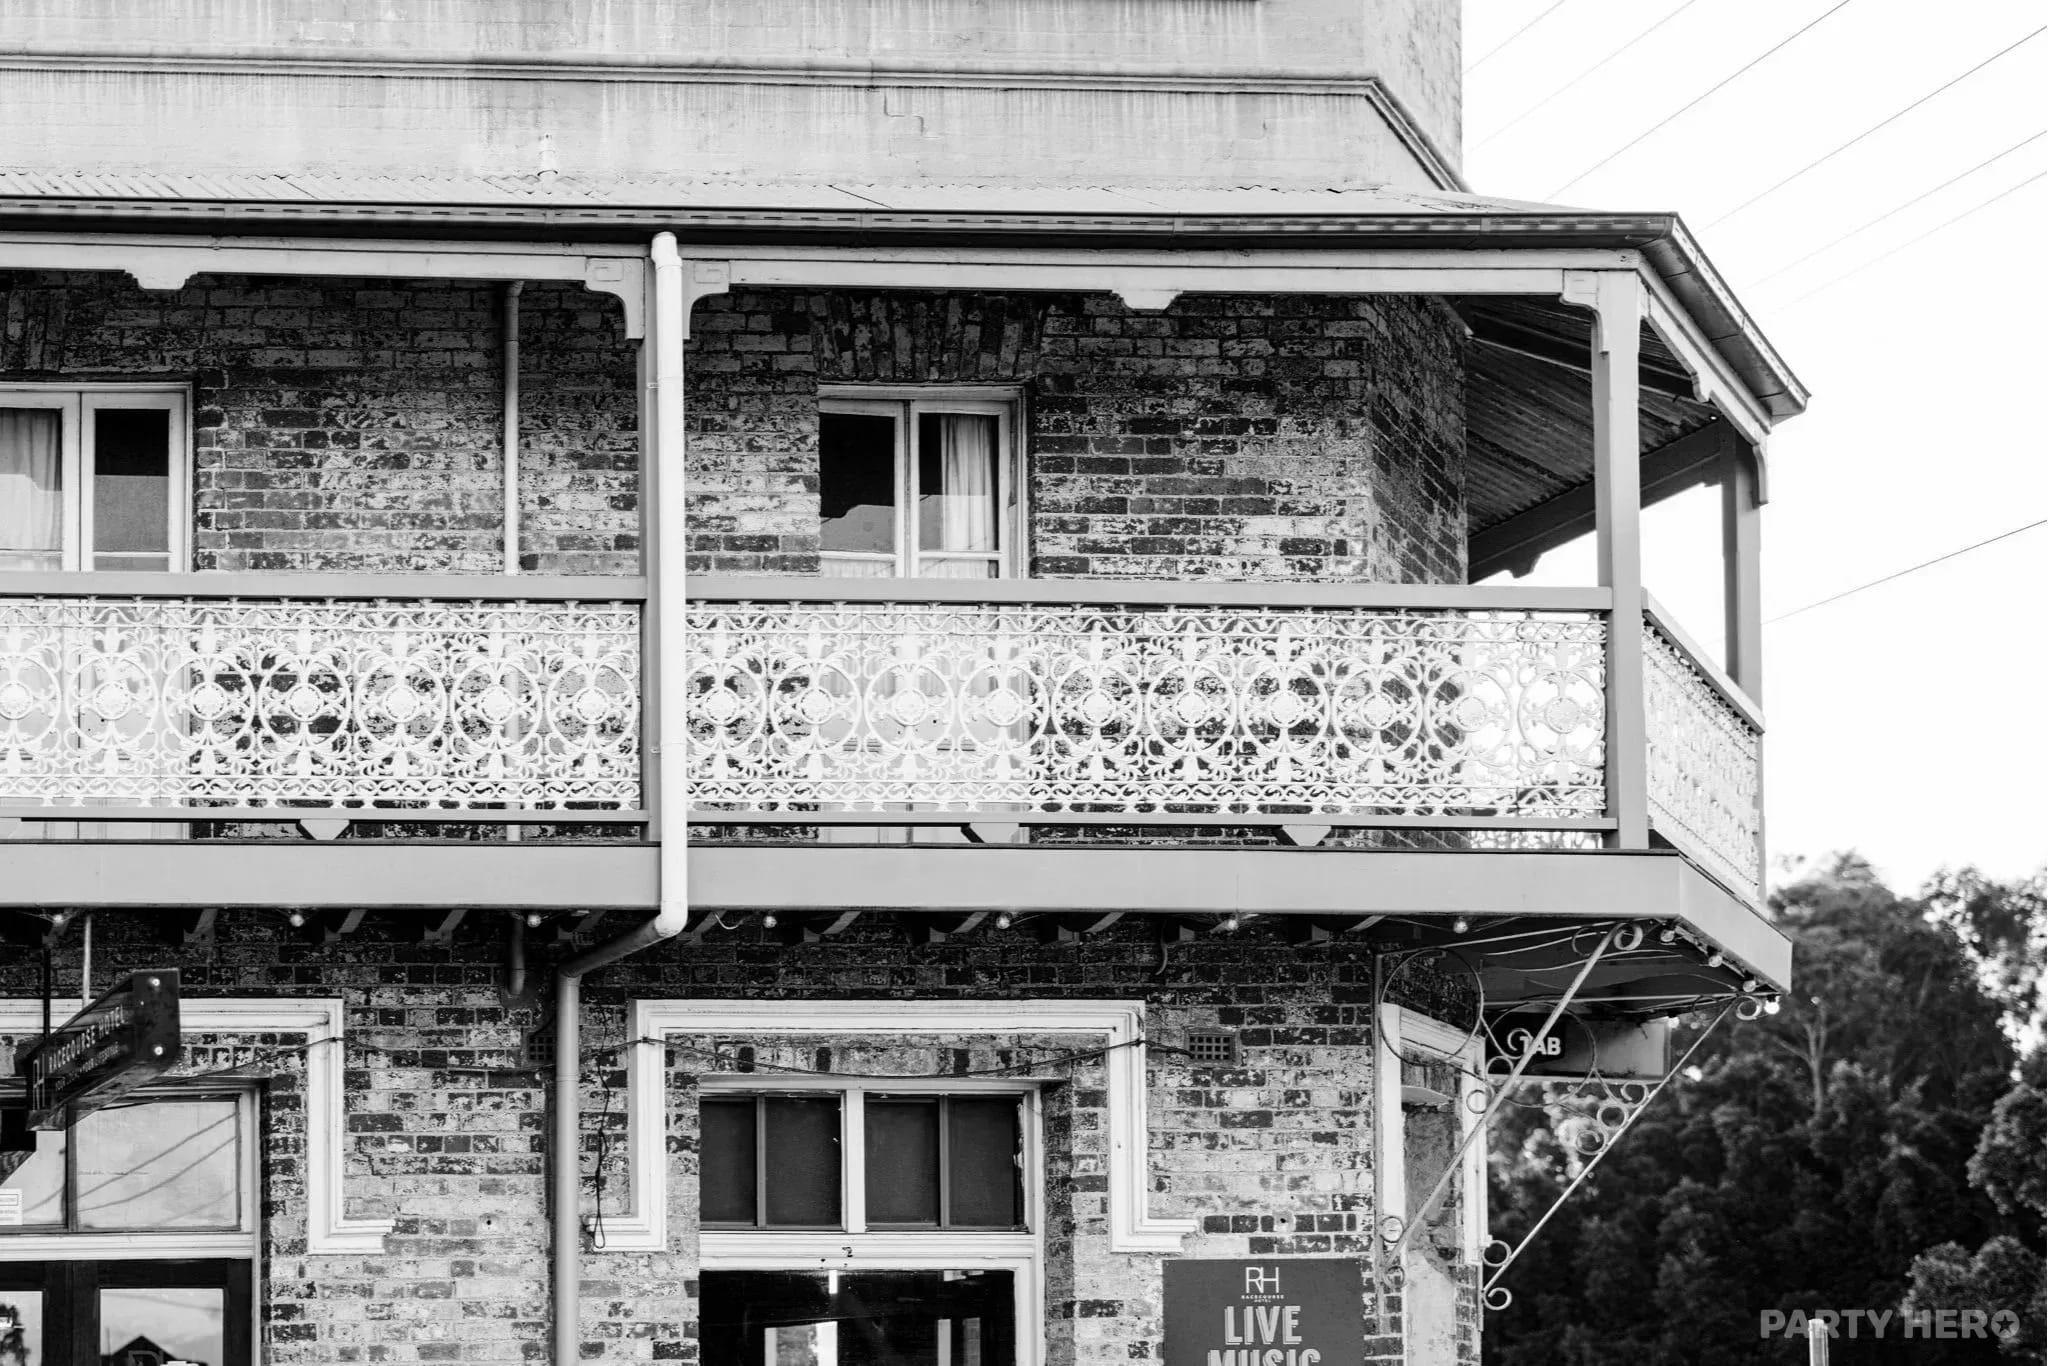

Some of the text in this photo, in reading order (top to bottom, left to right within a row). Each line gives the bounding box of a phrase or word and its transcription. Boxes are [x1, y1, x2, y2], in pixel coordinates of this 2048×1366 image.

[49, 1024, 96, 1074] RACECOURSE
[98, 1004, 128, 1039] HOTEL
[1519, 1036, 1561, 1055] TAB
[1245, 1266, 1279, 1293] RH
[1224, 1306, 1302, 1345] LIVE
